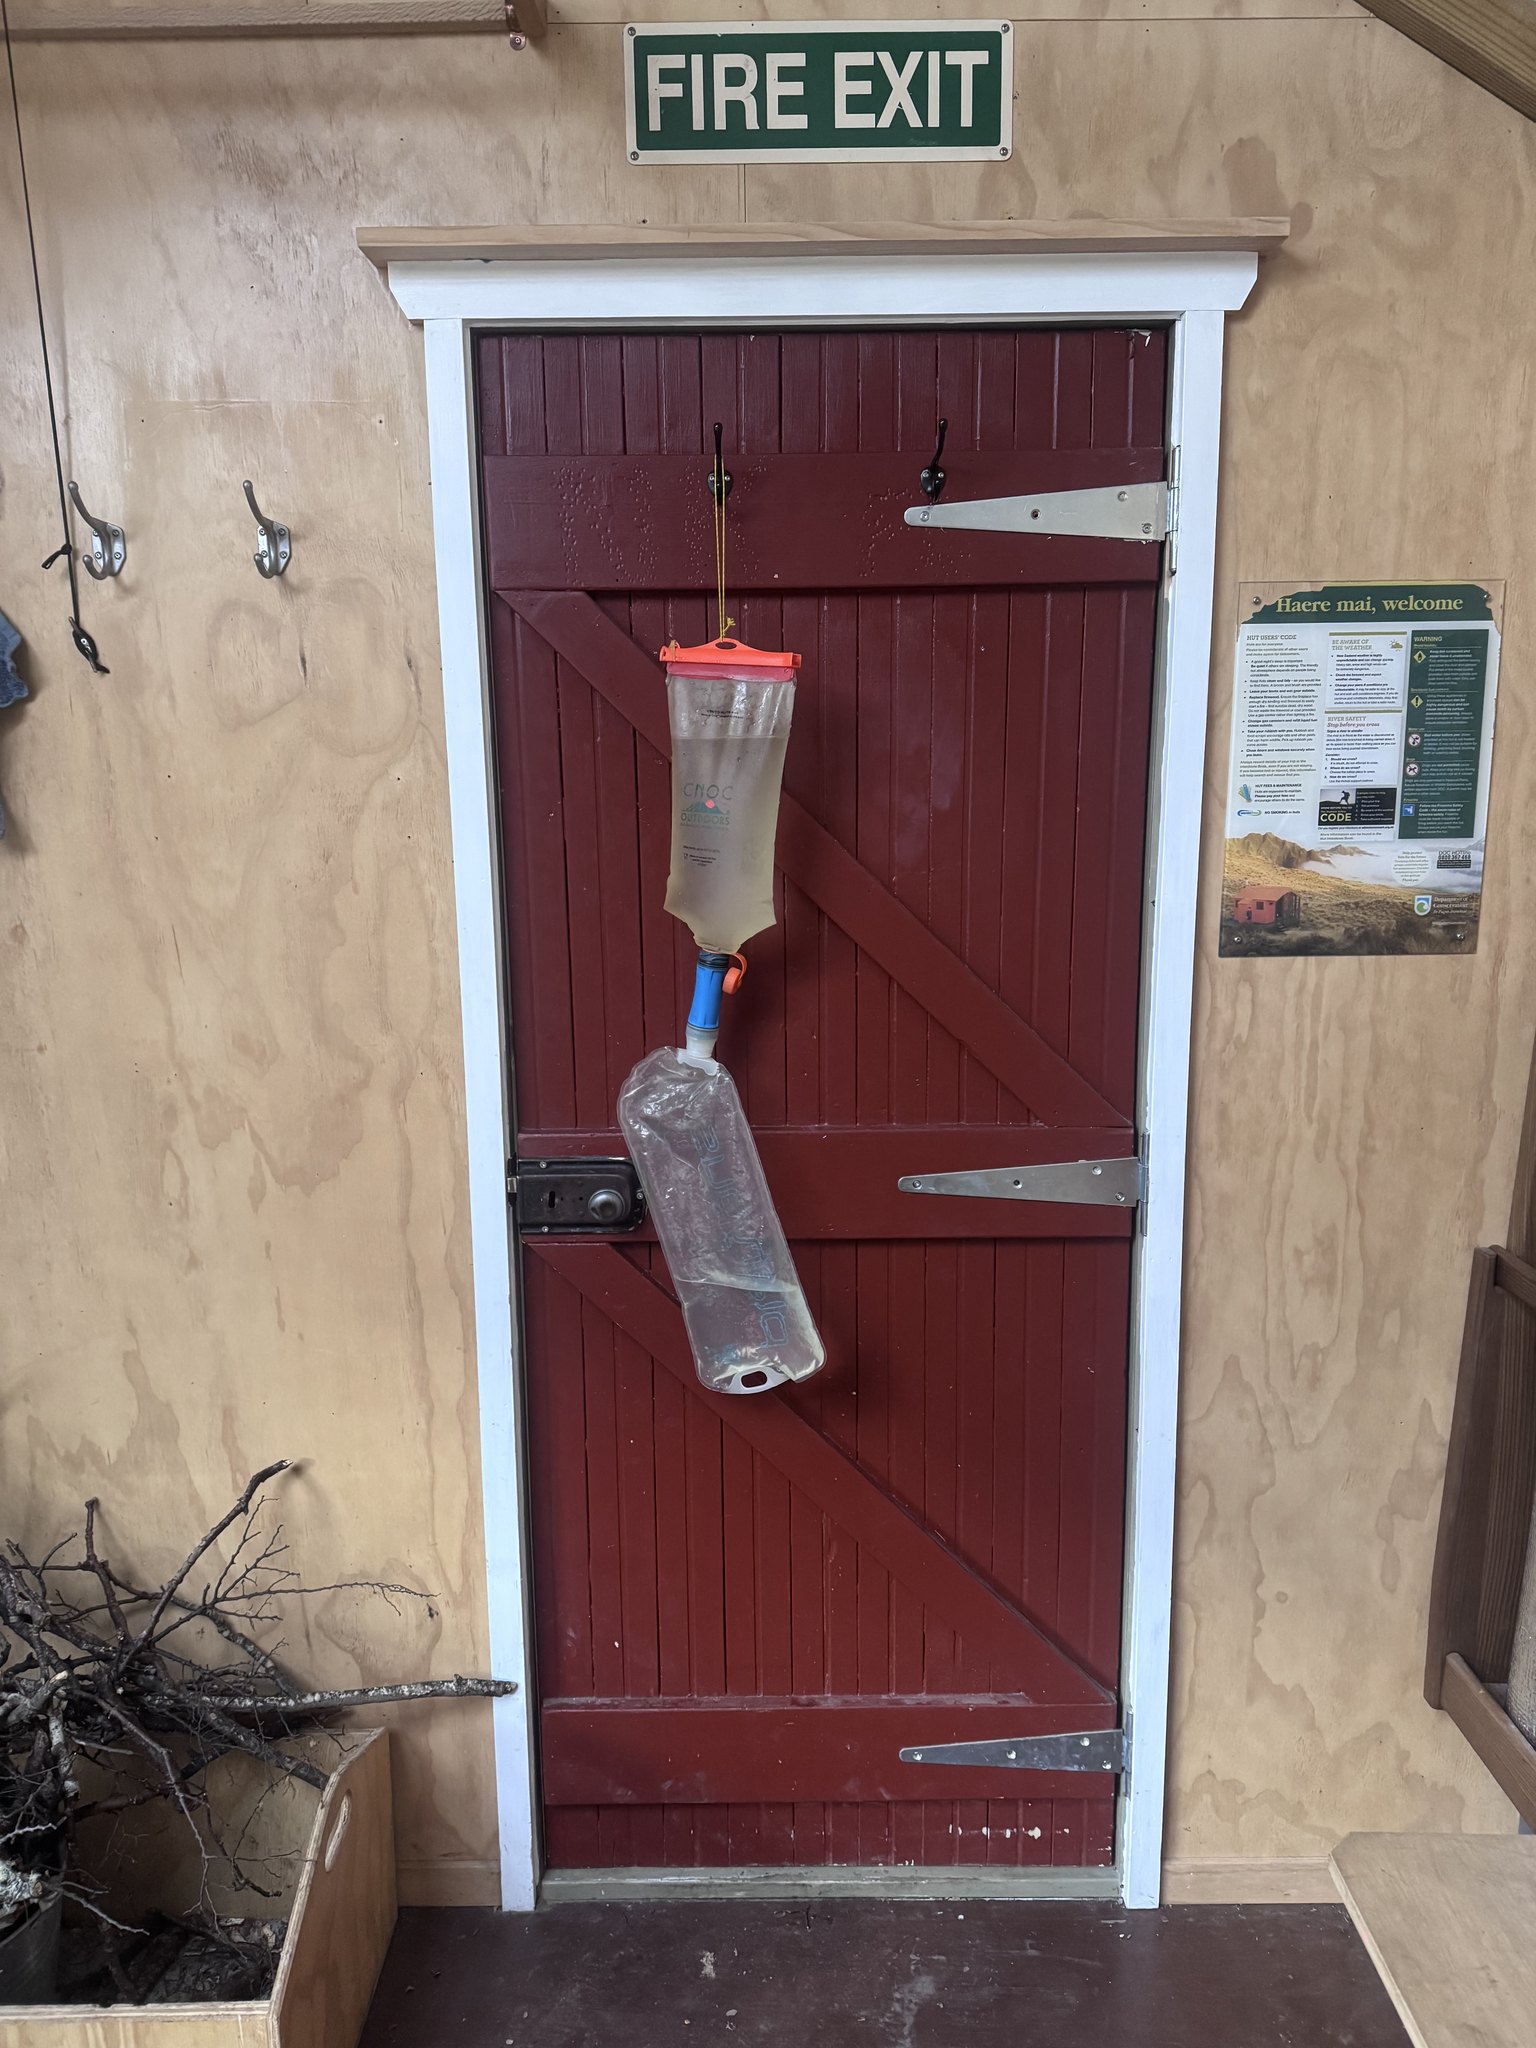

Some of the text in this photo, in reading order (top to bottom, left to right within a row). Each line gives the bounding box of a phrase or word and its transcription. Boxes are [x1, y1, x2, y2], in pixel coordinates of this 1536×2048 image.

[647, 51, 989, 131] FIRE EXIT
[1276, 595, 1463, 614] Haere mai, welcome
[683, 782, 734, 800] CNOC
[1320, 813, 1352, 822] CODE
